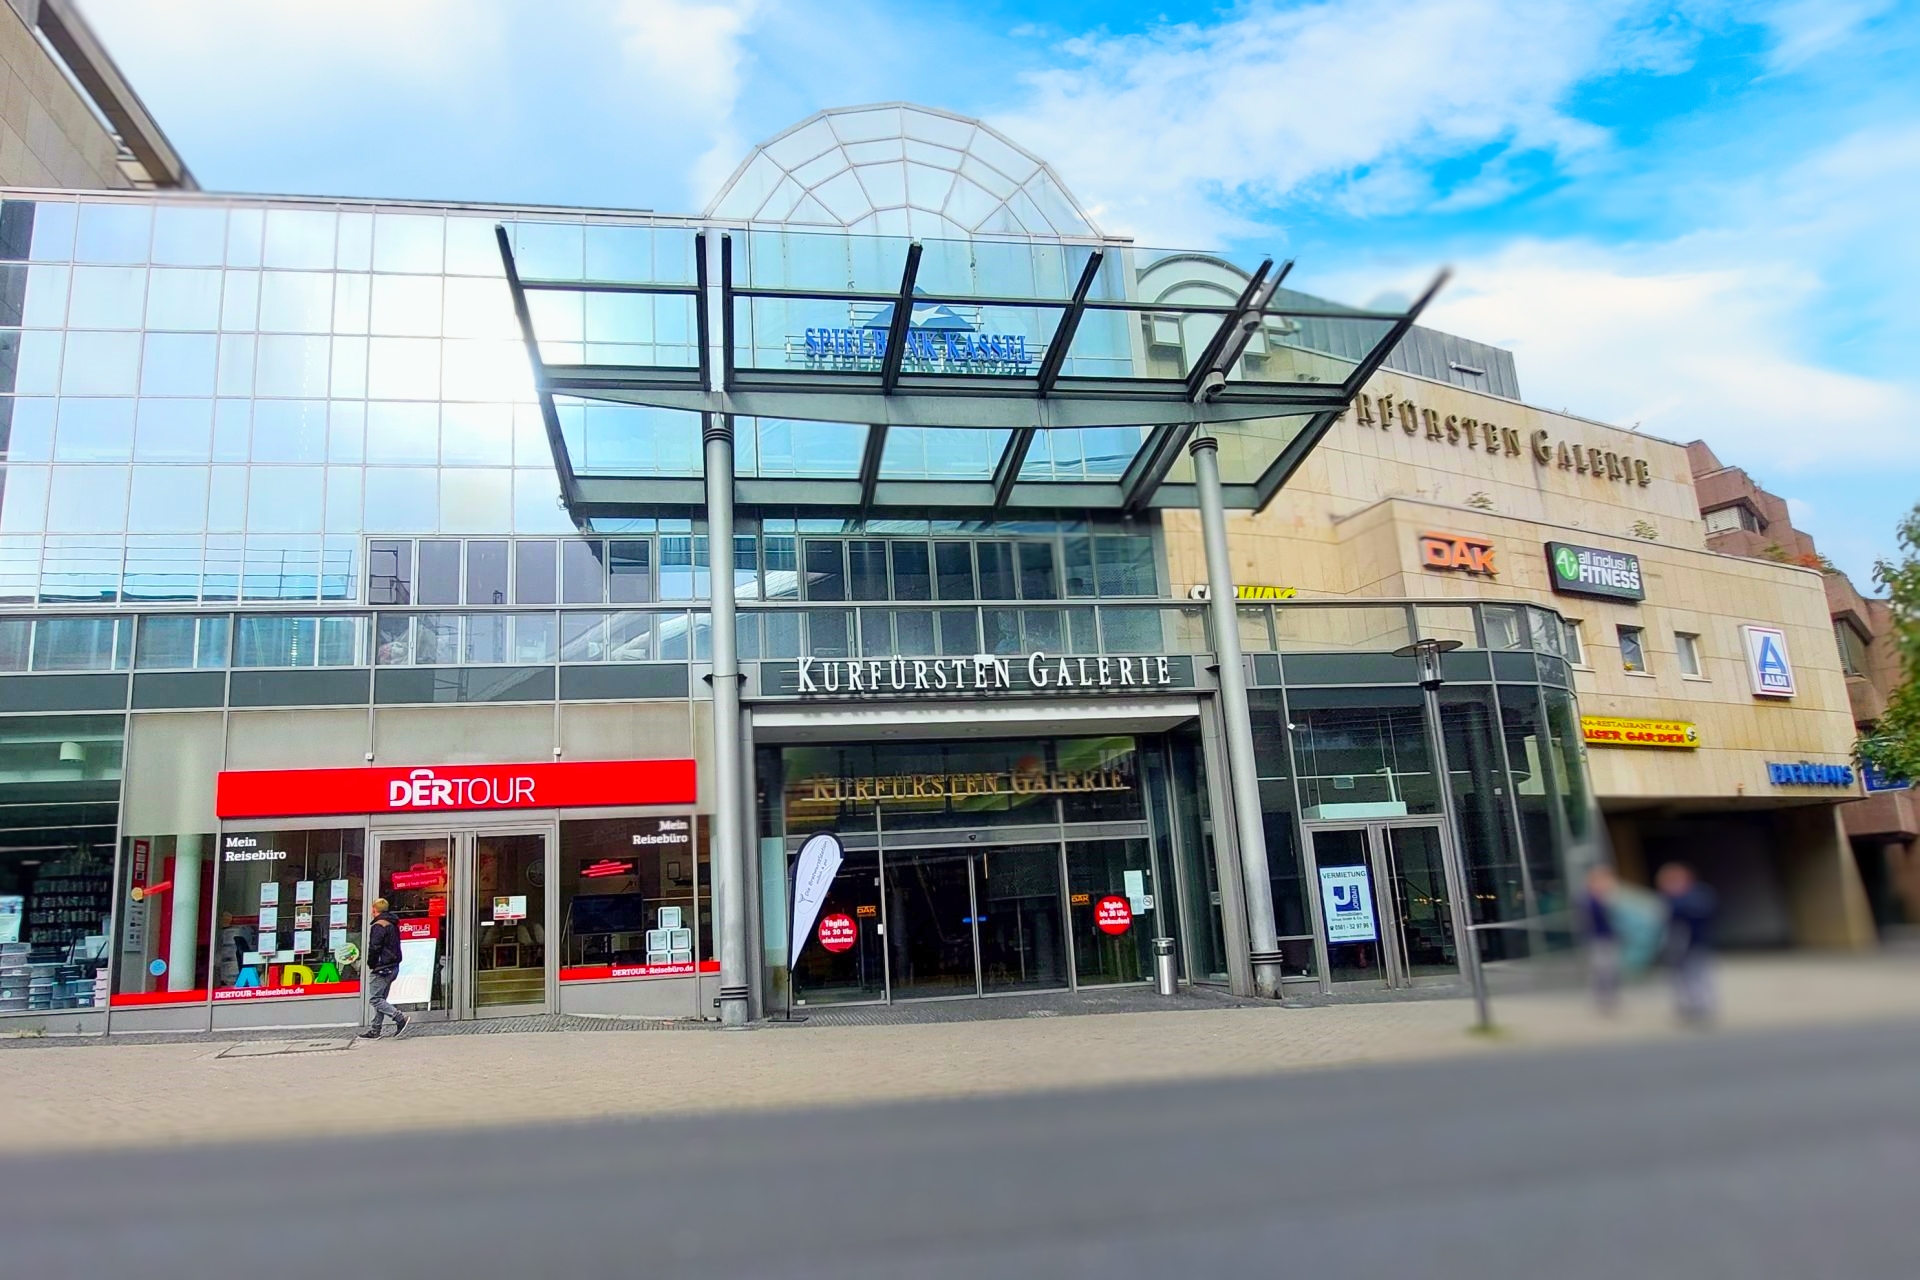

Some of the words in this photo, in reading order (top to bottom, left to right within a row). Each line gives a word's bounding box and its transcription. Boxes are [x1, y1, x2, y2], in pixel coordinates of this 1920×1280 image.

[805, 327, 939, 361] SPIELBNK
[944, 331, 1033, 365] KASSEL
[1340, 392, 1522, 457] RFÜRSTEN
[1530, 429, 1651, 488] GALERIE
[1420, 531, 1500, 576] DAK
[1578, 551, 1591, 565] all
[1592, 552, 1638, 572] inclusive
[1579, 565, 1640, 590] FITNESS
[1189, 585, 1297, 604] SWAY
[797, 655, 1011, 693] KURFÜRSTEN
[1028, 651, 1172, 687] GALERIE
[1763, 674, 1789, 687] ALDI
[1583, 729, 1623, 742] AISER
[1625, 731, 1685, 744] GARDEN
[1768, 762, 1854, 786] PARKHAUS
[389, 769, 536, 807] DERTOUR
[813, 771, 999, 801] KURFÜRSTEN
[1011, 767, 1125, 796] GALERIE
[658, 819, 689, 832] Mein
[225, 836, 258, 848] Mein
[632, 833, 689, 845] Reisebüro
[225, 849, 287, 862] Reisebüro
[1321, 870, 1366, 879] VERMIETUNG
[1351, 884, 1360, 910] JORDAN
[1099, 910, 1108, 918] bis
[1117, 909, 1128, 917] Uhr
[824, 919, 850, 928] Täglich
[822, 928, 831, 936] bis
[822, 936, 854, 944] einkaufen!
[235, 961, 341, 988] AIDA
[612, 966, 694, 977] DERTOUR-Reisebüro.de
[214, 987, 305, 999] DERTOUR-Reisebüro.de
